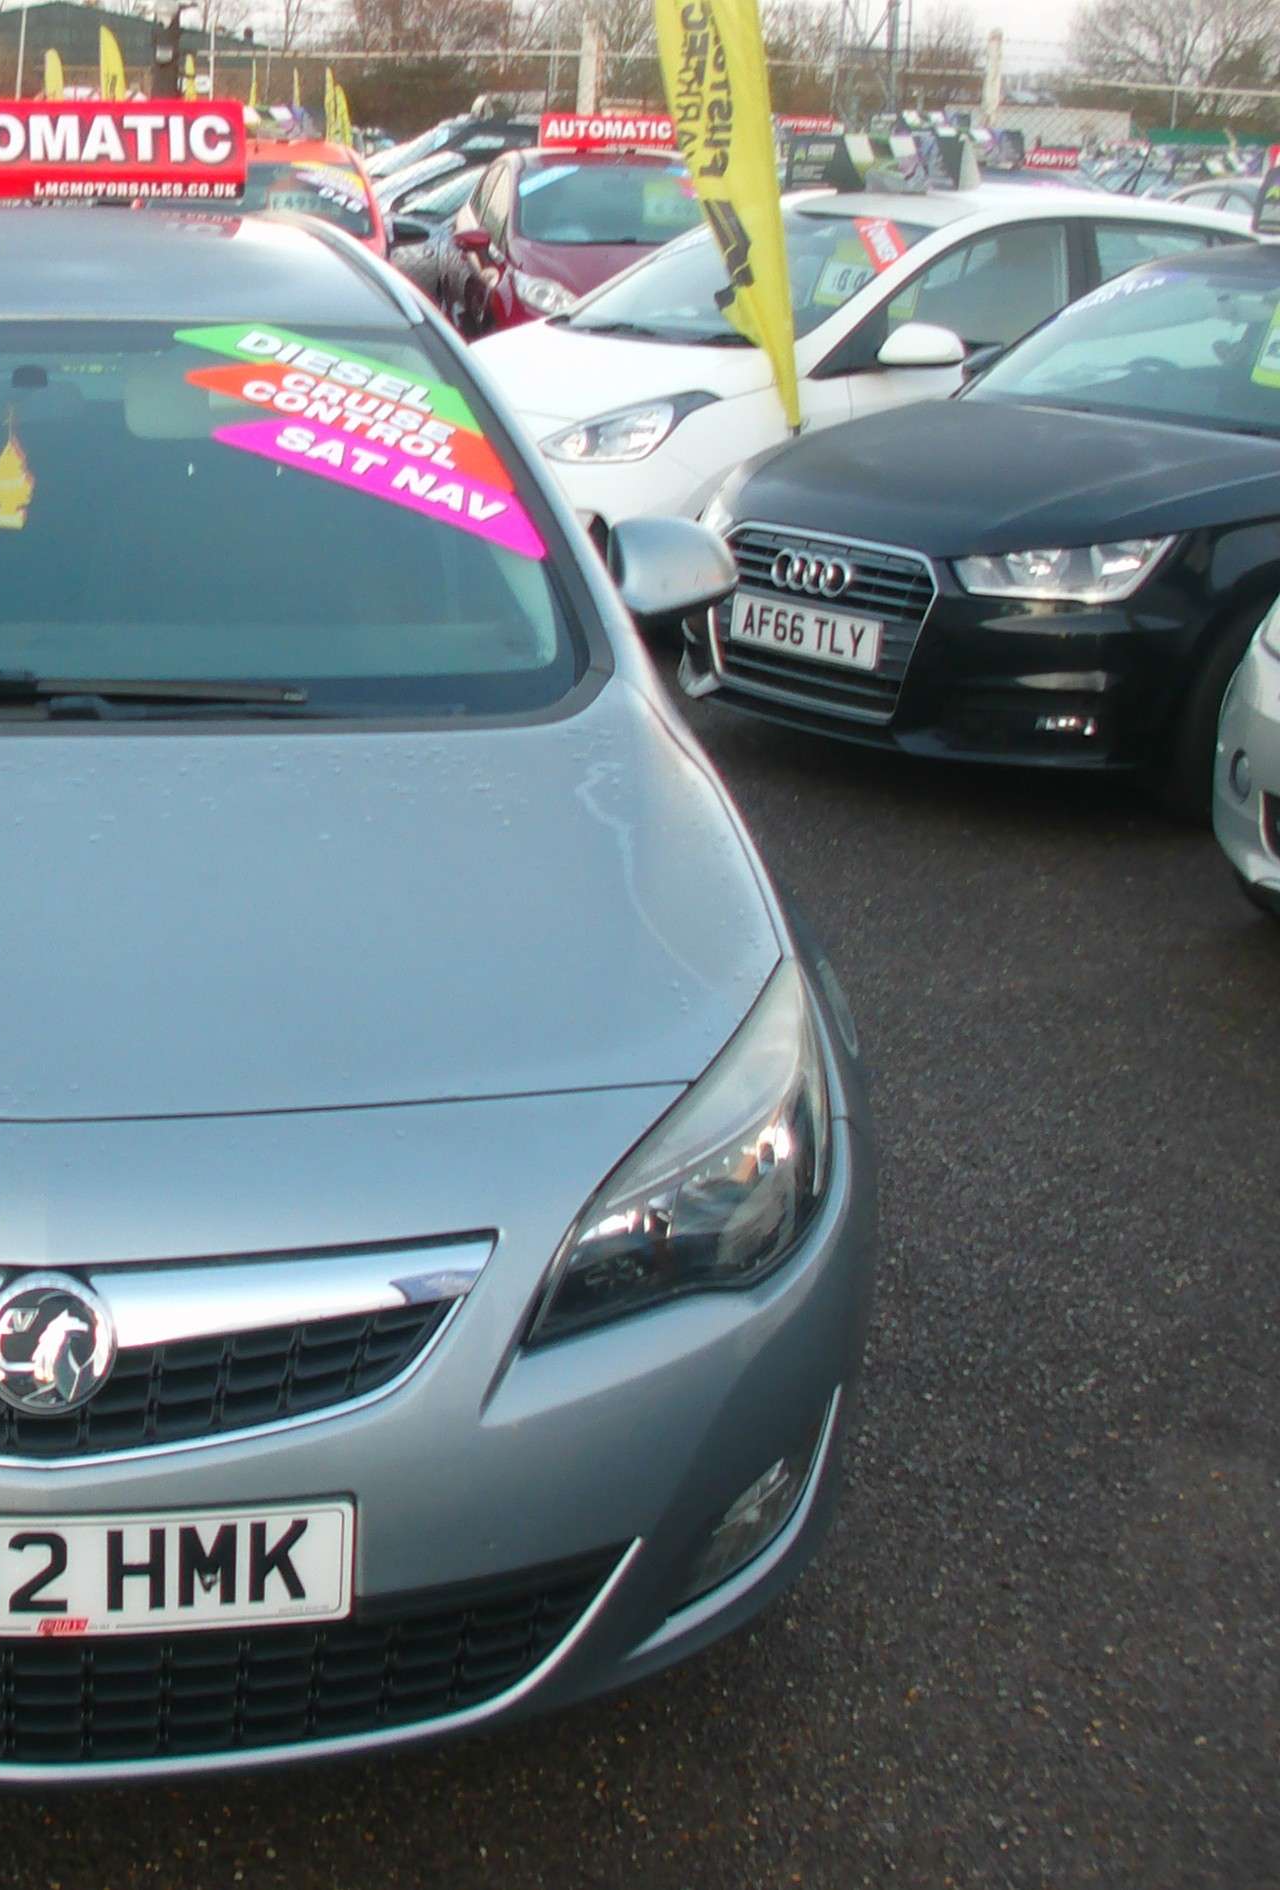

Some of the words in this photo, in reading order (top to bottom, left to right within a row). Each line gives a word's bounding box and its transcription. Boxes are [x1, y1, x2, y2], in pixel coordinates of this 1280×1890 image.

[545, 119, 673, 140] AUTOMATIC
[34, 181, 237, 198] LMCMOTORSALES.CO.UK
[236, 330, 433, 413] DIESEL
[282, 373, 456, 445] CRUISE
[242, 380, 456, 471] CONTROL
[275, 427, 388, 476] SAT
[390, 466, 508, 522] NAV
[741, 602, 805, 646] AF66
[814, 616, 866, 658] TLY
[106, 1519, 309, 1612] HMK
